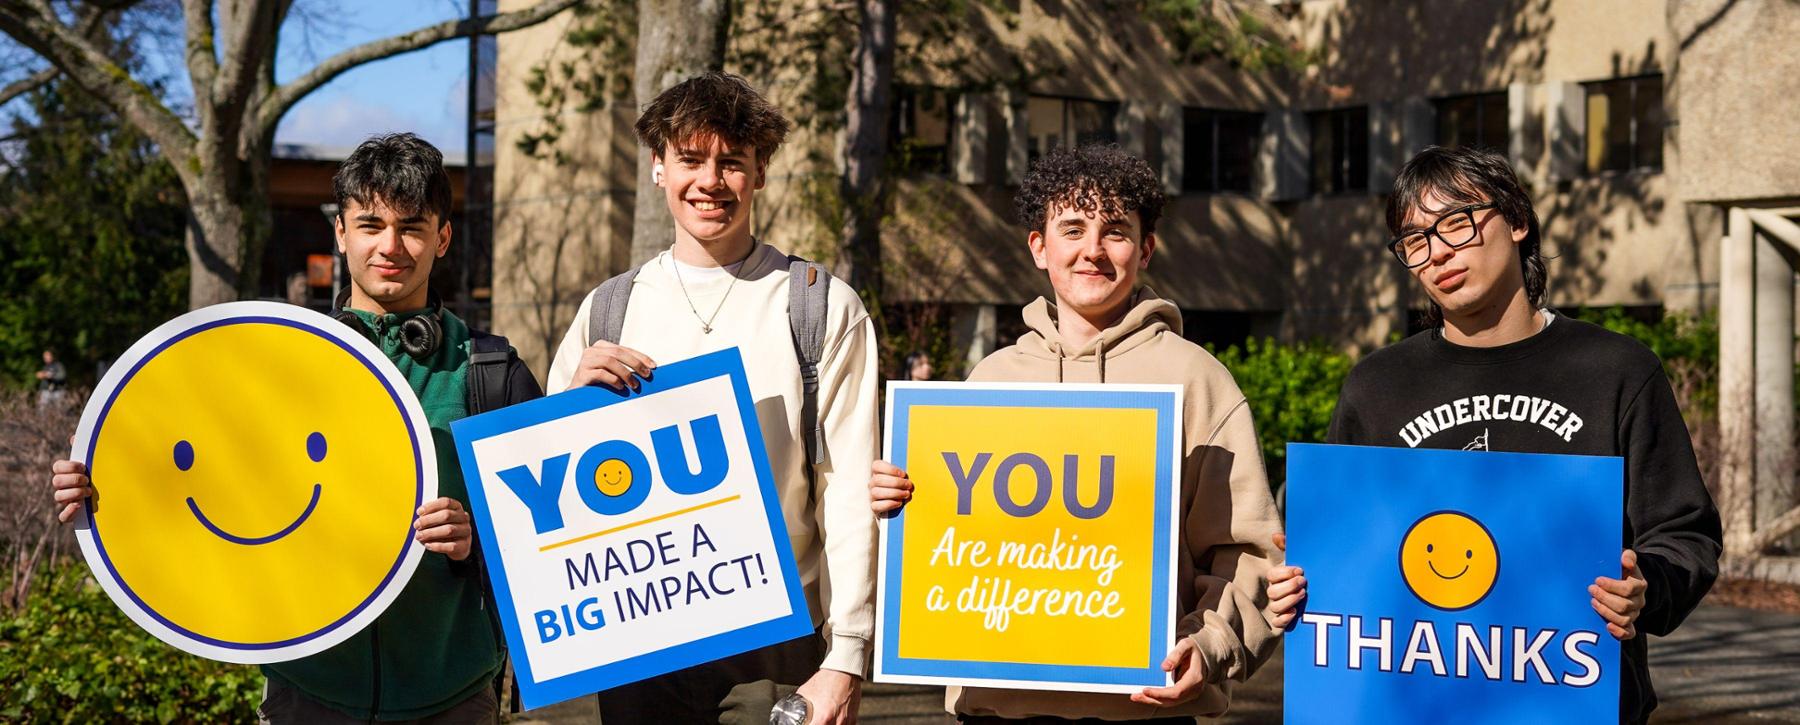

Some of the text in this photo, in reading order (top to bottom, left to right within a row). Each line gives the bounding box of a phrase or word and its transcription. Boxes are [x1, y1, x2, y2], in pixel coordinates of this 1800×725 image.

[1399, 394, 1584, 448] UNDERCOVER
[495, 414, 730, 535] YOU
[941, 451, 1115, 520] YOU
[565, 523, 717, 590] MADE A
[929, 526, 1123, 586] Are making
[534, 553, 769, 644] BIG IMPACT!
[926, 575, 1125, 632] a difference
[1302, 611, 1602, 688] THANKS
